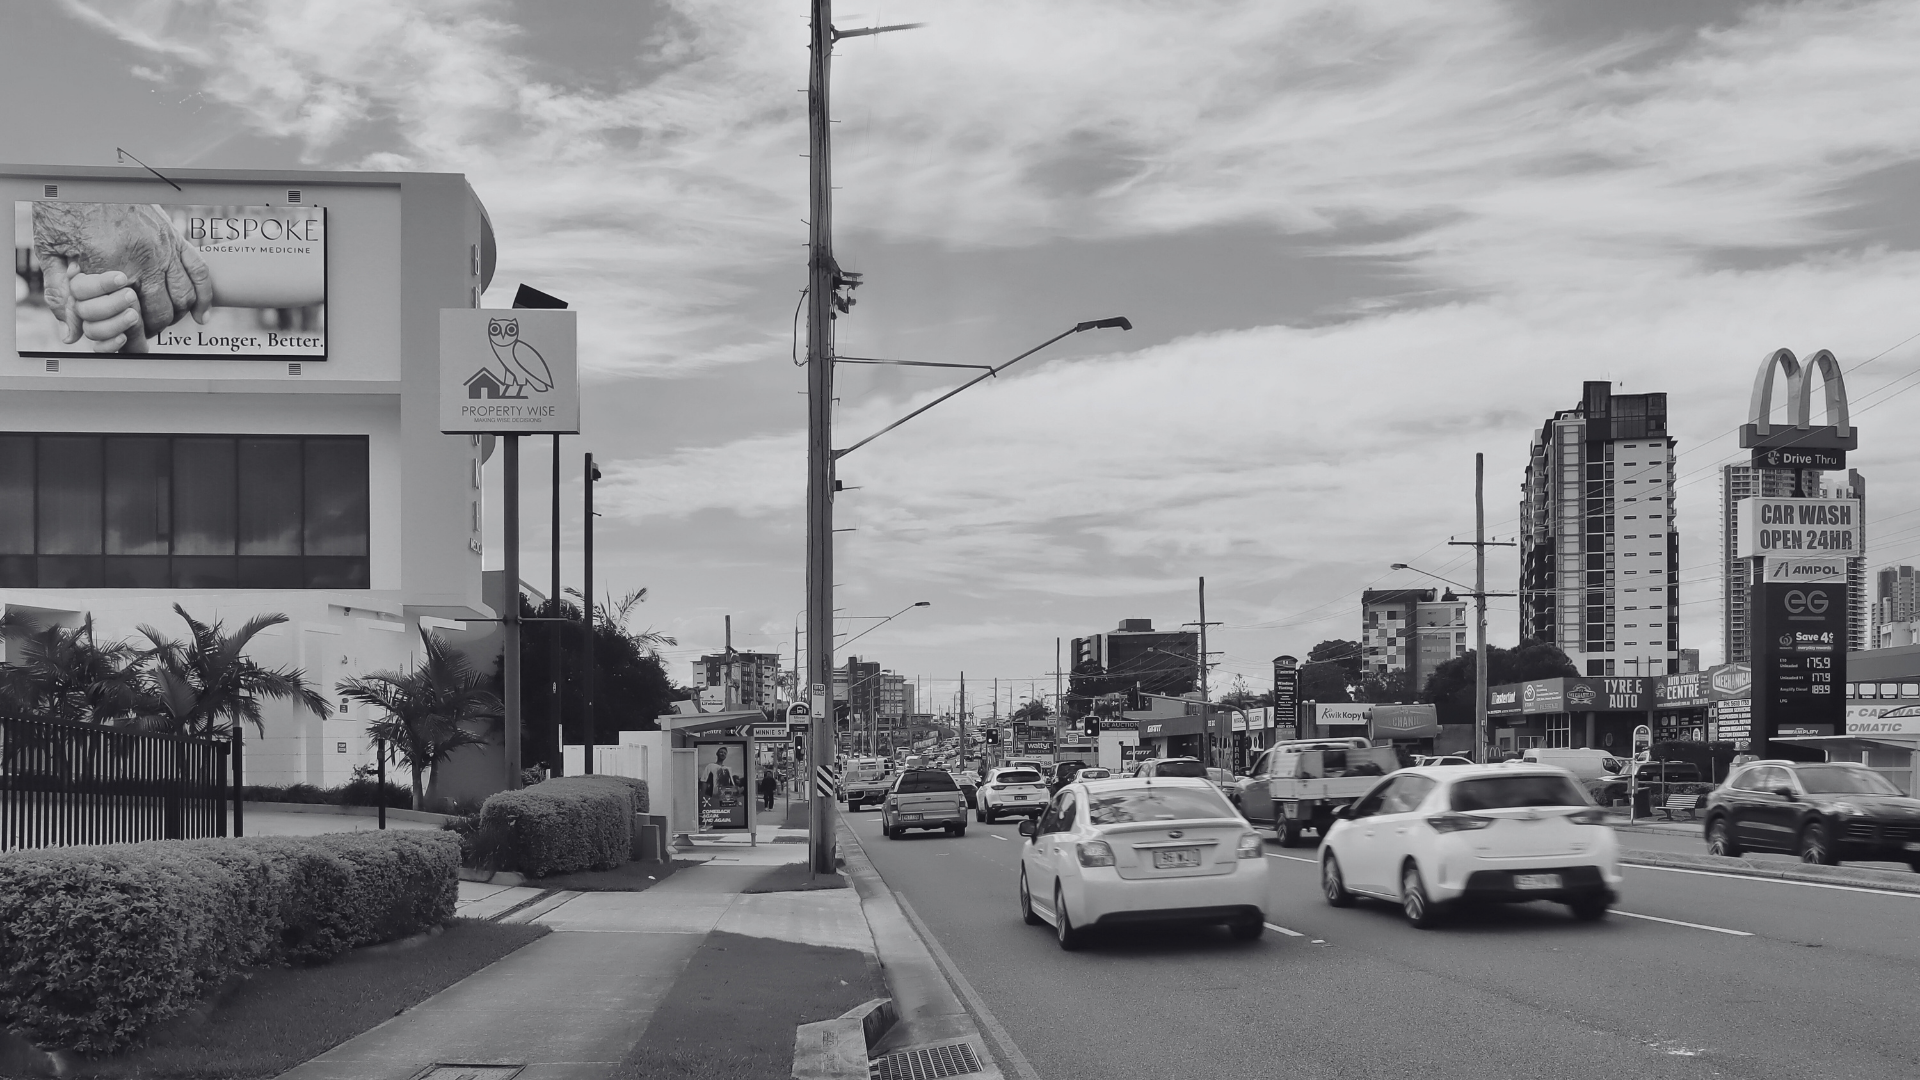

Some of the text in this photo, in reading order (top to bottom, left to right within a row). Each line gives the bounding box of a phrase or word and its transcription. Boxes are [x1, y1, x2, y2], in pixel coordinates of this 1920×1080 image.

[190, 217, 319, 241] BESPOKE
[200, 245, 311, 254] LONGEVITY MEDICINE
[156, 331, 324, 352] Live Longer, Better.
[461, 405, 555, 417] PROPERTY WISE
[1783, 453, 1837, 465] Drive Thru
[1761, 504, 1851, 525] CAR WASH
[1759, 529, 1852, 550] OPEN 24HR
[1792, 566, 1839, 575] AMPOL
[1796, 632, 1819, 641] Save
[1806, 657, 1831, 669] 175.9
[1667, 676, 1680, 686] AUTO
[1680, 673, 1700, 685] SERVICE
[1604, 679, 1643, 694] TYRE &
[1667, 683, 1700, 700] CENTRE
[1609, 694, 1638, 709] AUTO
[1321, 707, 1362, 721] Kwik Kopy
[1027, 742, 1050, 750] wattyl
